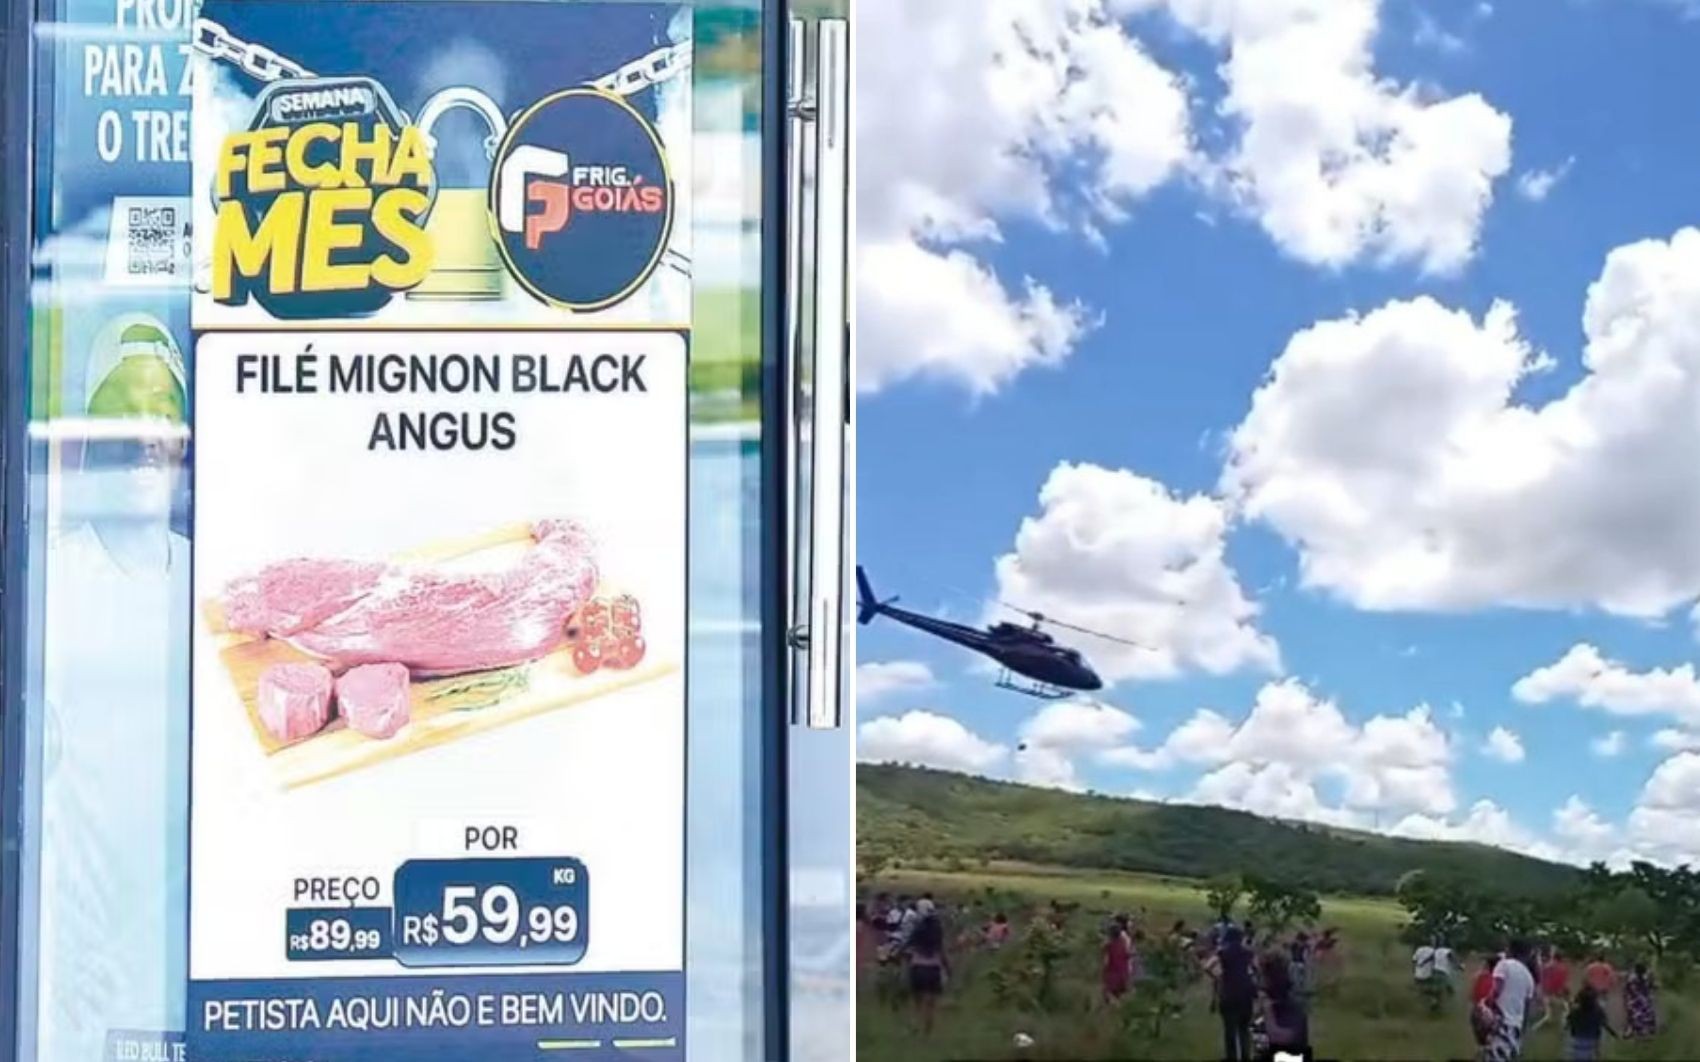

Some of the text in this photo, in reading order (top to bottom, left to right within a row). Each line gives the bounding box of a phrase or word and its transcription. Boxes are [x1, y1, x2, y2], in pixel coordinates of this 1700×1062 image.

[84, 44, 168, 97] PARA
[279, 87, 365, 113] SEMANA
[97, 110, 122, 162] O
[216, 122, 432, 198] FECHA
[573, 174, 662, 212] GOIÁS
[236, 344, 647, 393] FILÉ MIGNON BLACK
[367, 412, 517, 451] ANGUS
[464, 826, 518, 850] POR
[553, 868, 575, 884] KG
[204, 990, 667, 1030] PETISTA AQUI NÃO E BEM VINDO.
